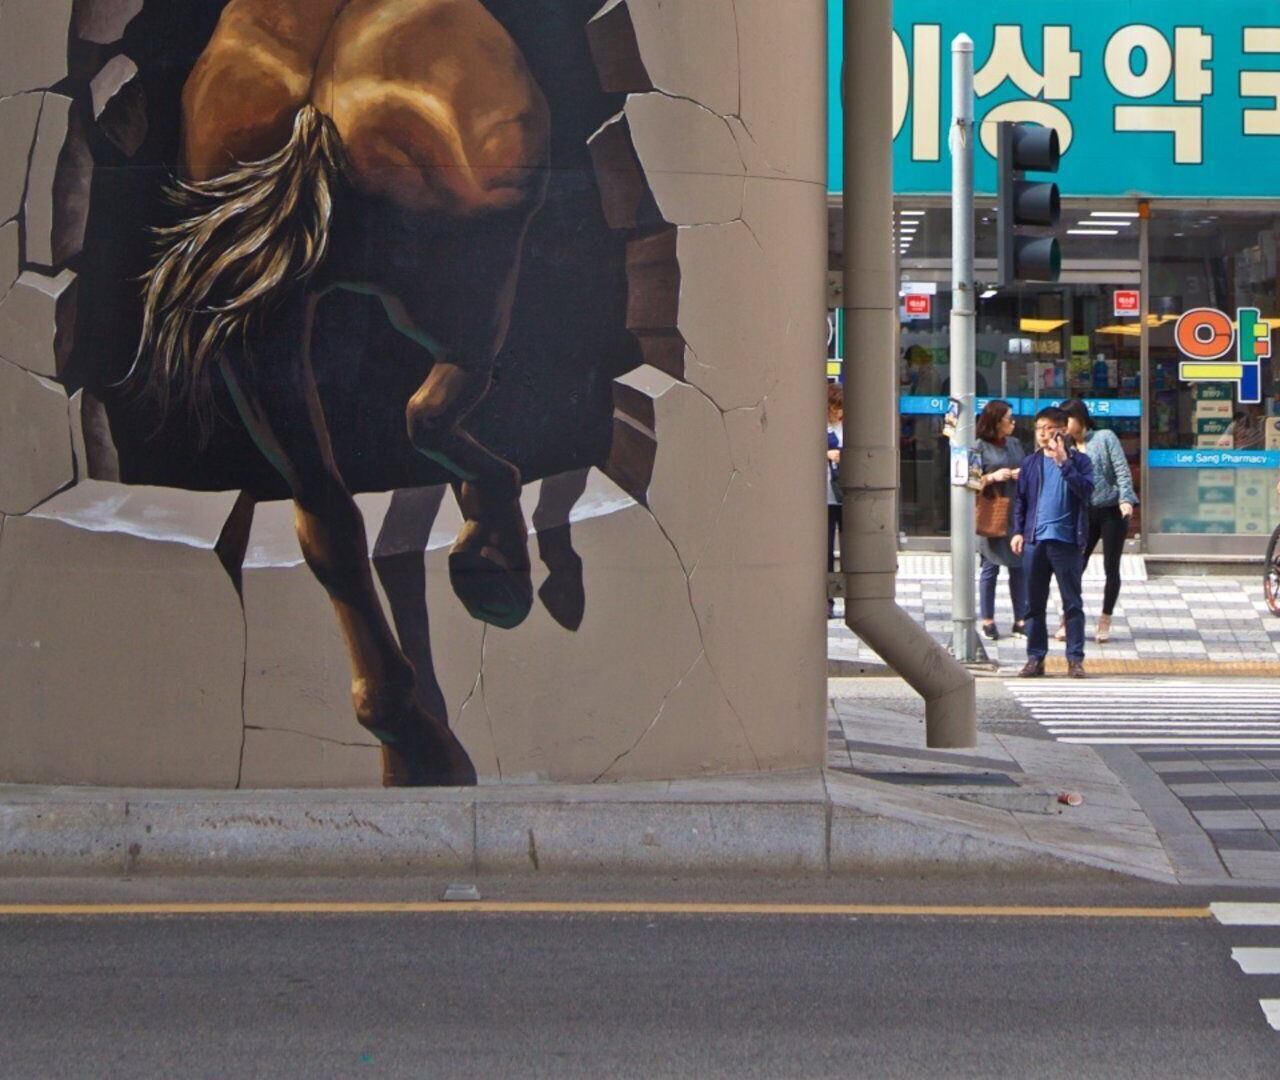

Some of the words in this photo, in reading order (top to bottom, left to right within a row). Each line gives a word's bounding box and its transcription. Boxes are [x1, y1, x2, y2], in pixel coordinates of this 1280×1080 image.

[1174, 306, 1272, 404] 약
[1177, 453, 1193, 463] Lee
[1196, 453, 1220, 464] Sang
[1222, 453, 1267, 464] Pharmacy
